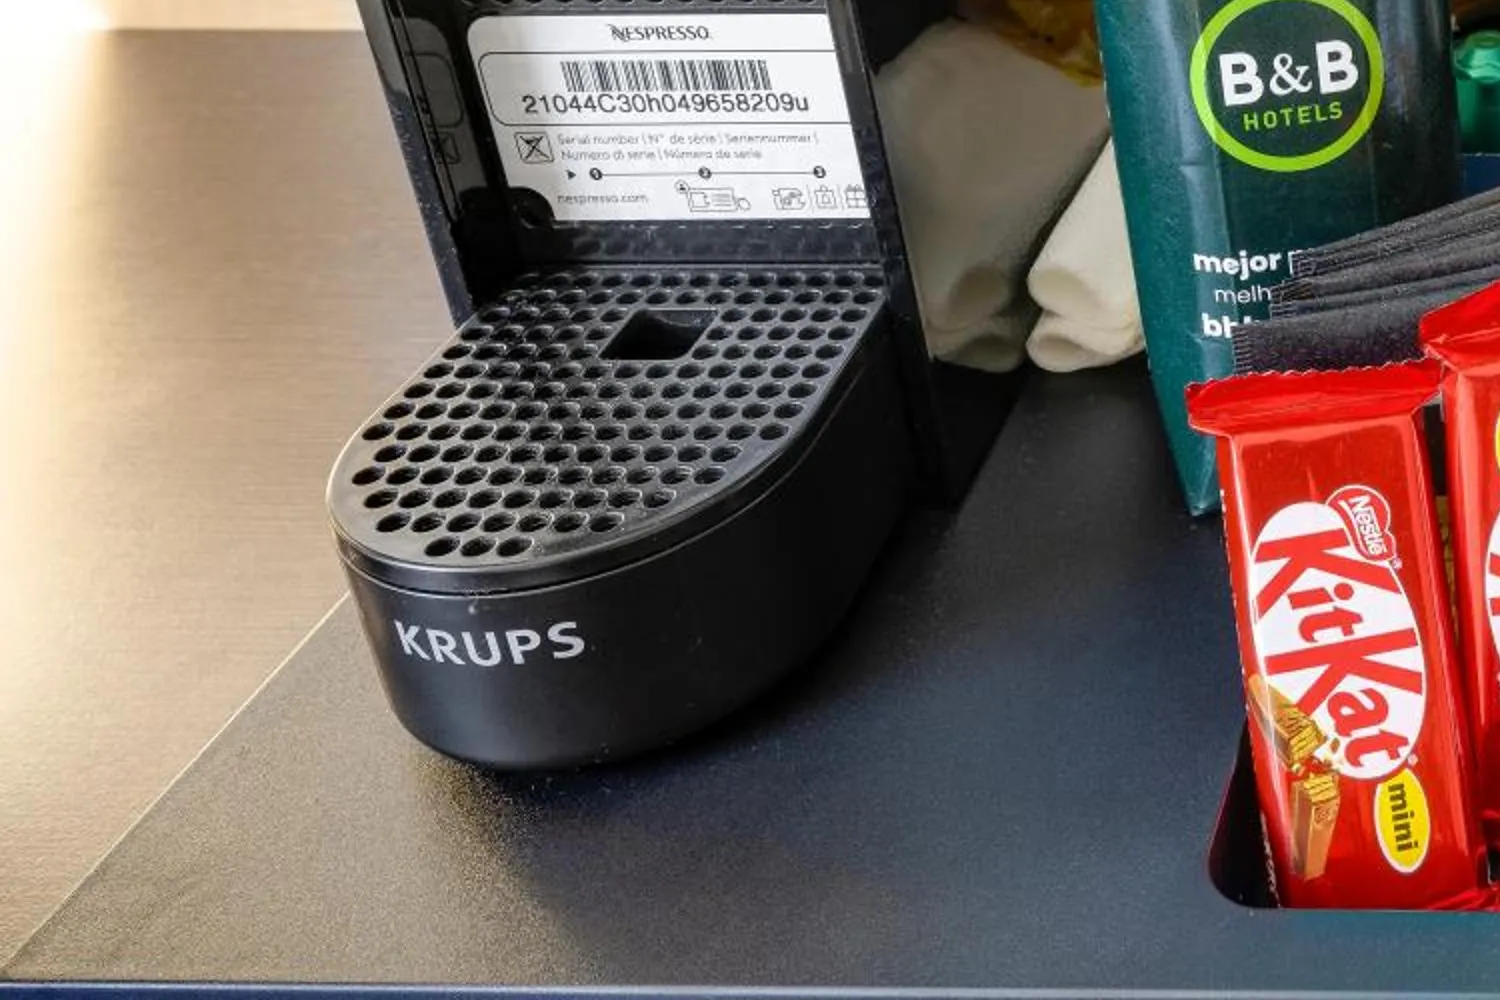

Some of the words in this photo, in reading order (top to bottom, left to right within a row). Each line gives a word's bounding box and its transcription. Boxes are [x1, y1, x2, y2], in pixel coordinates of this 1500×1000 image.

[608, 23, 710, 42] NESPRESSO
[1218, 39, 1360, 106] B&B
[1242, 101, 1344, 131] HOTELS
[1192, 249, 1282, 281] mejor
[394, 619, 586, 667] KRUPS
[1255, 527, 1424, 768] KitKat
[1388, 783, 1418, 852] mini
